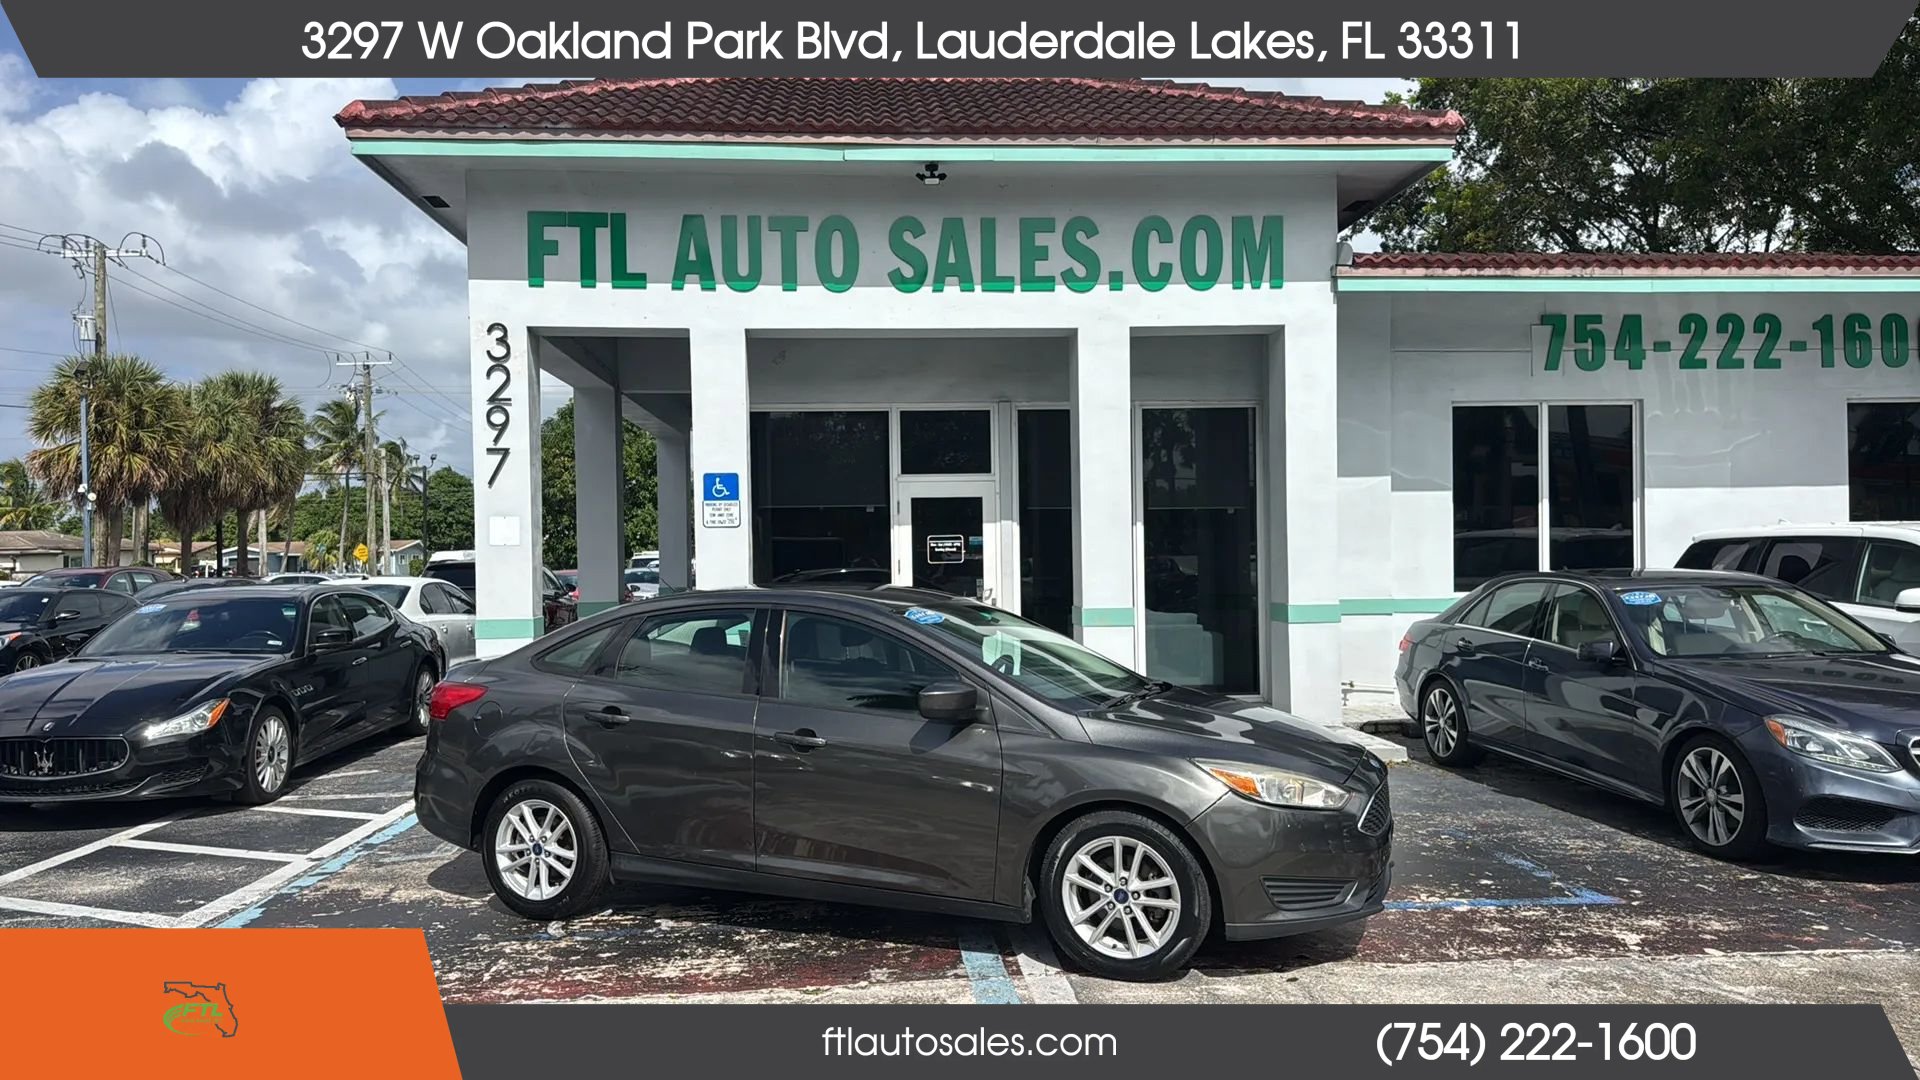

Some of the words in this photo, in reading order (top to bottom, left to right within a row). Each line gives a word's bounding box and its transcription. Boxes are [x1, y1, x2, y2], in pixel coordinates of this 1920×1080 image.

[527, 210, 647, 289] FTL
[671, 214, 860, 293] AUTO
[888, 215, 1284, 294] SALES.COM
[1540, 312, 1920, 372] 754-222-160
[485, 322, 512, 488] 3297
